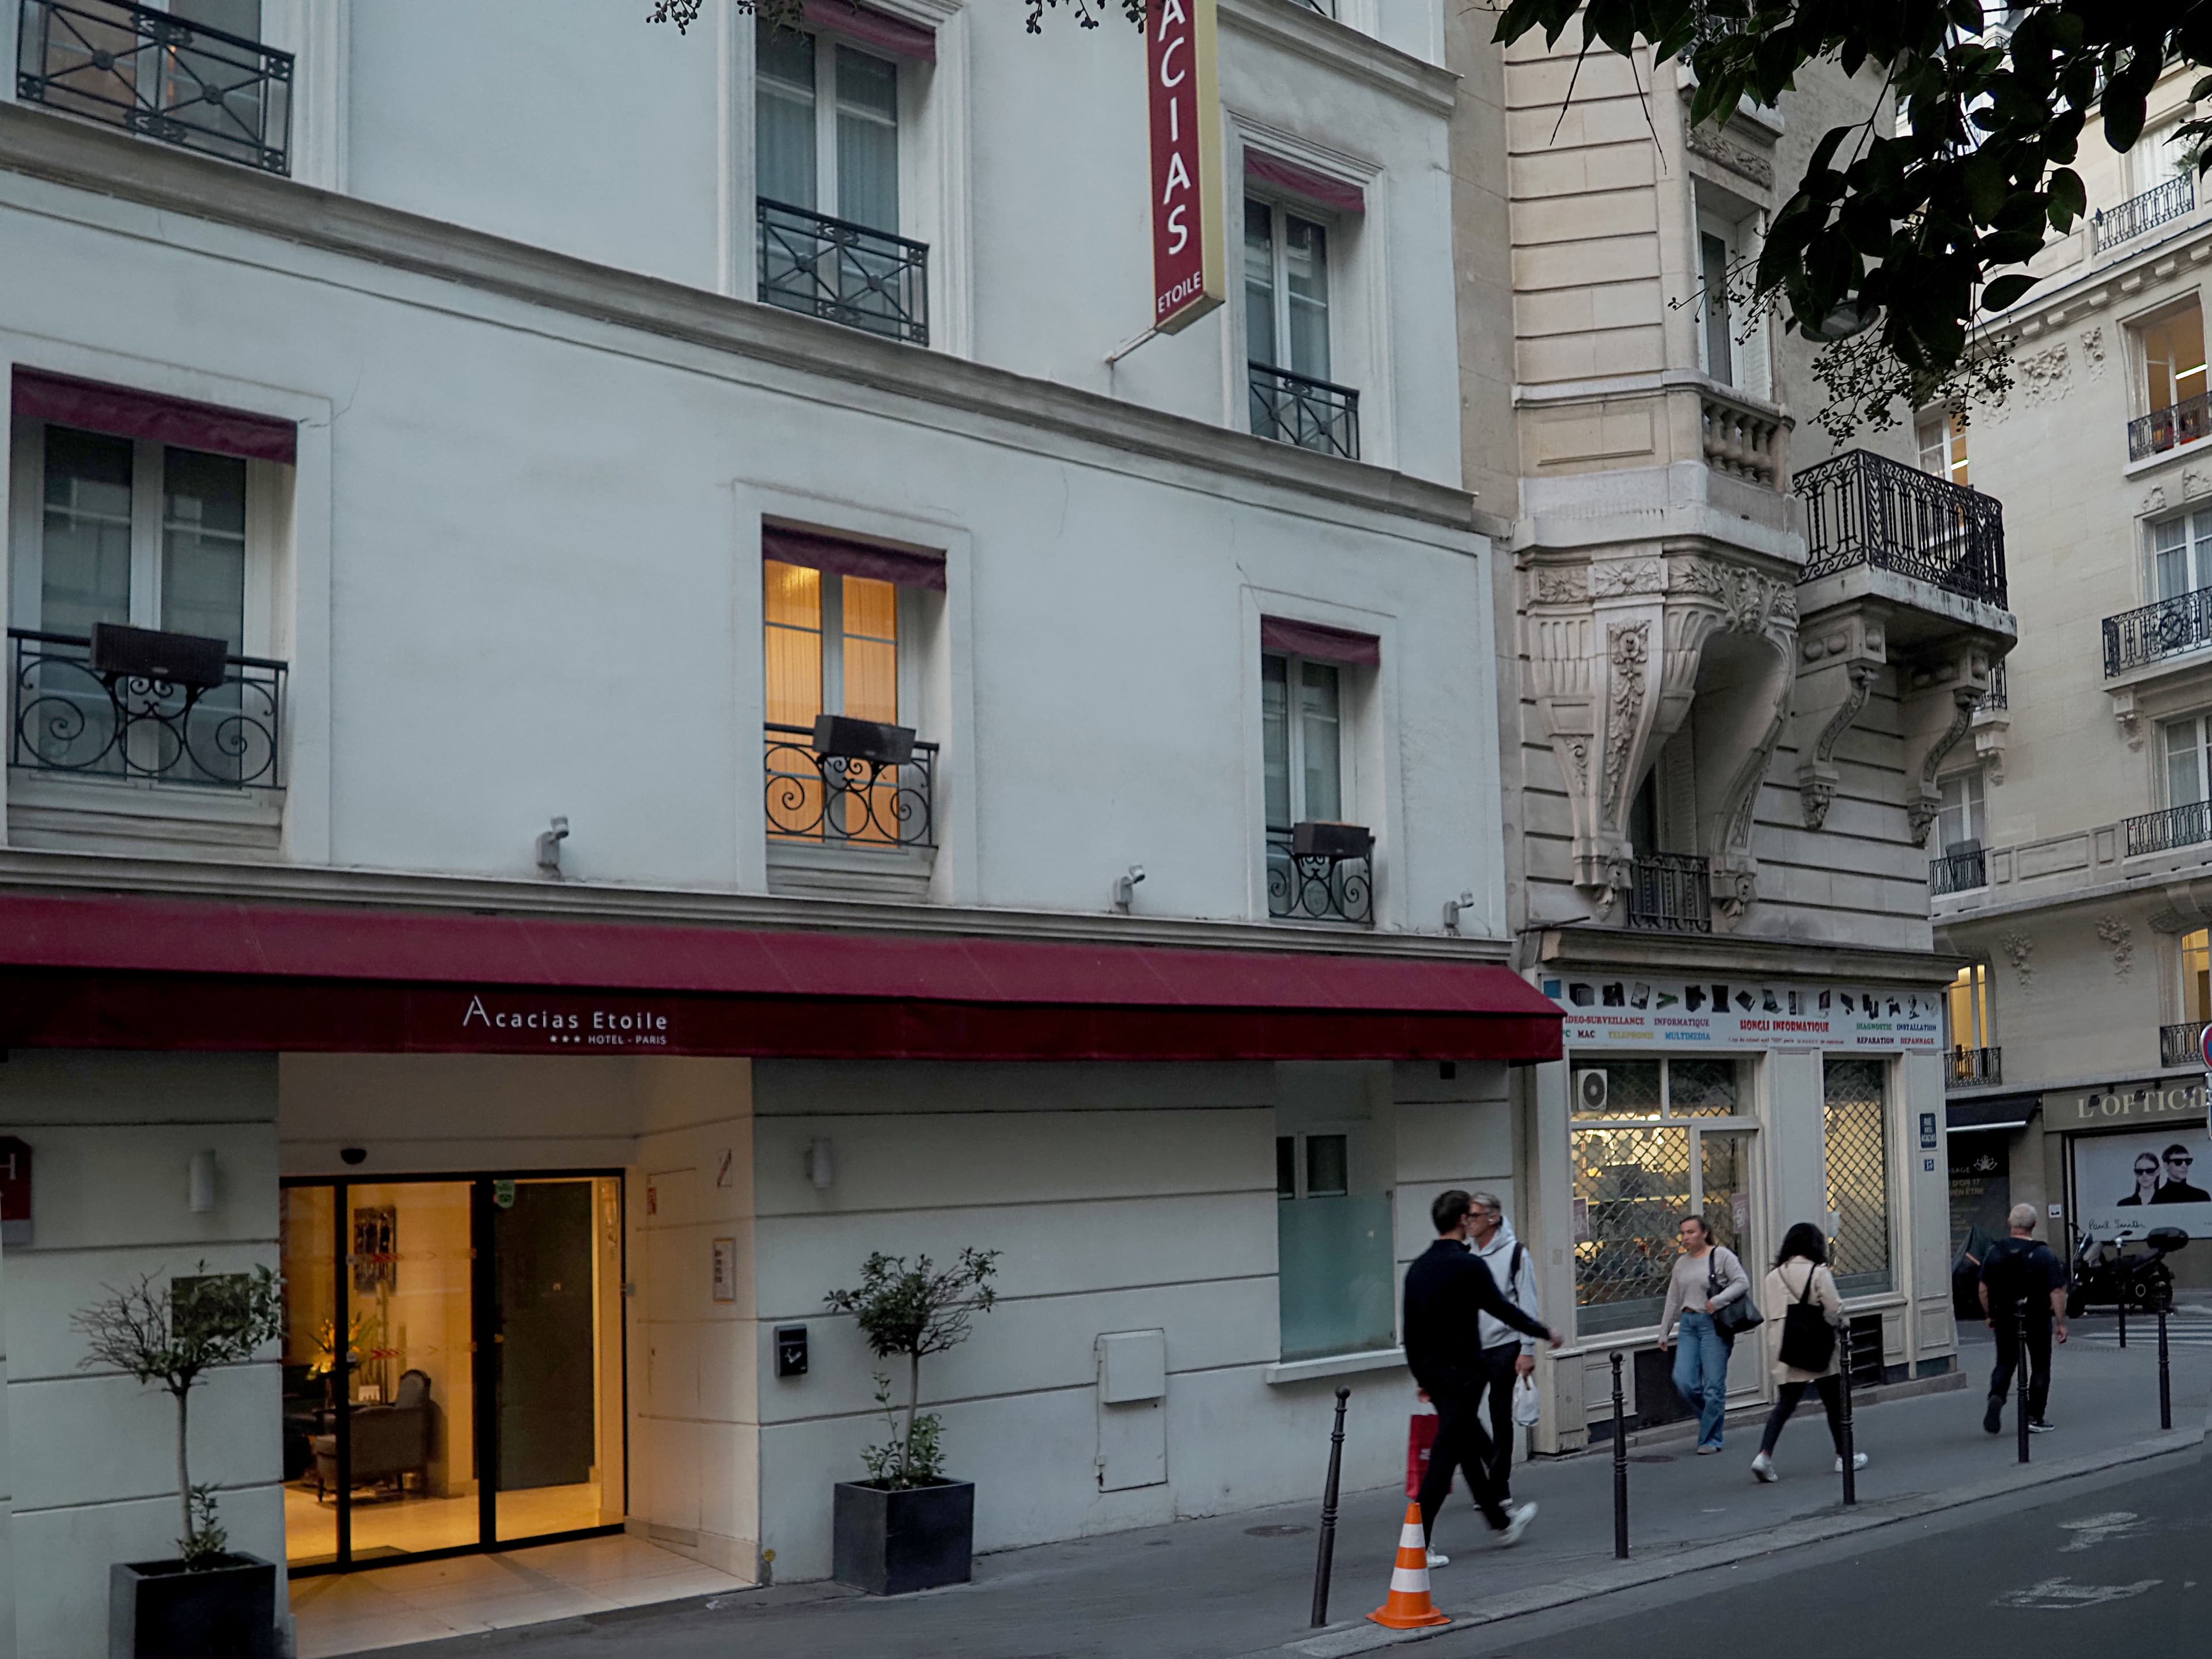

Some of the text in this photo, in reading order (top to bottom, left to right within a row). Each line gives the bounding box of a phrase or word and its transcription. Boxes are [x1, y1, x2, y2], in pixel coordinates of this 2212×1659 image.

[1157, 271, 1202, 315] ETOILE
[463, 994, 668, 1030] Acacias Etoile
[1654, 1017, 1710, 1028] INFORMATIQUE
[1740, 1020, 1830, 1033] HONGLI INFORMATIQUE
[1856, 1022, 1893, 1031] DIAGNOSTIC
[588, 1035, 624, 1044] HOTEL
[635, 1035, 668, 1046] PARIS
[1578, 1030, 1596, 1039] MAC
[1665, 1031, 1711, 1041] MULTIMEDIA
[1857, 1036, 1935, 1045] REPARATION DEPANNAGE
